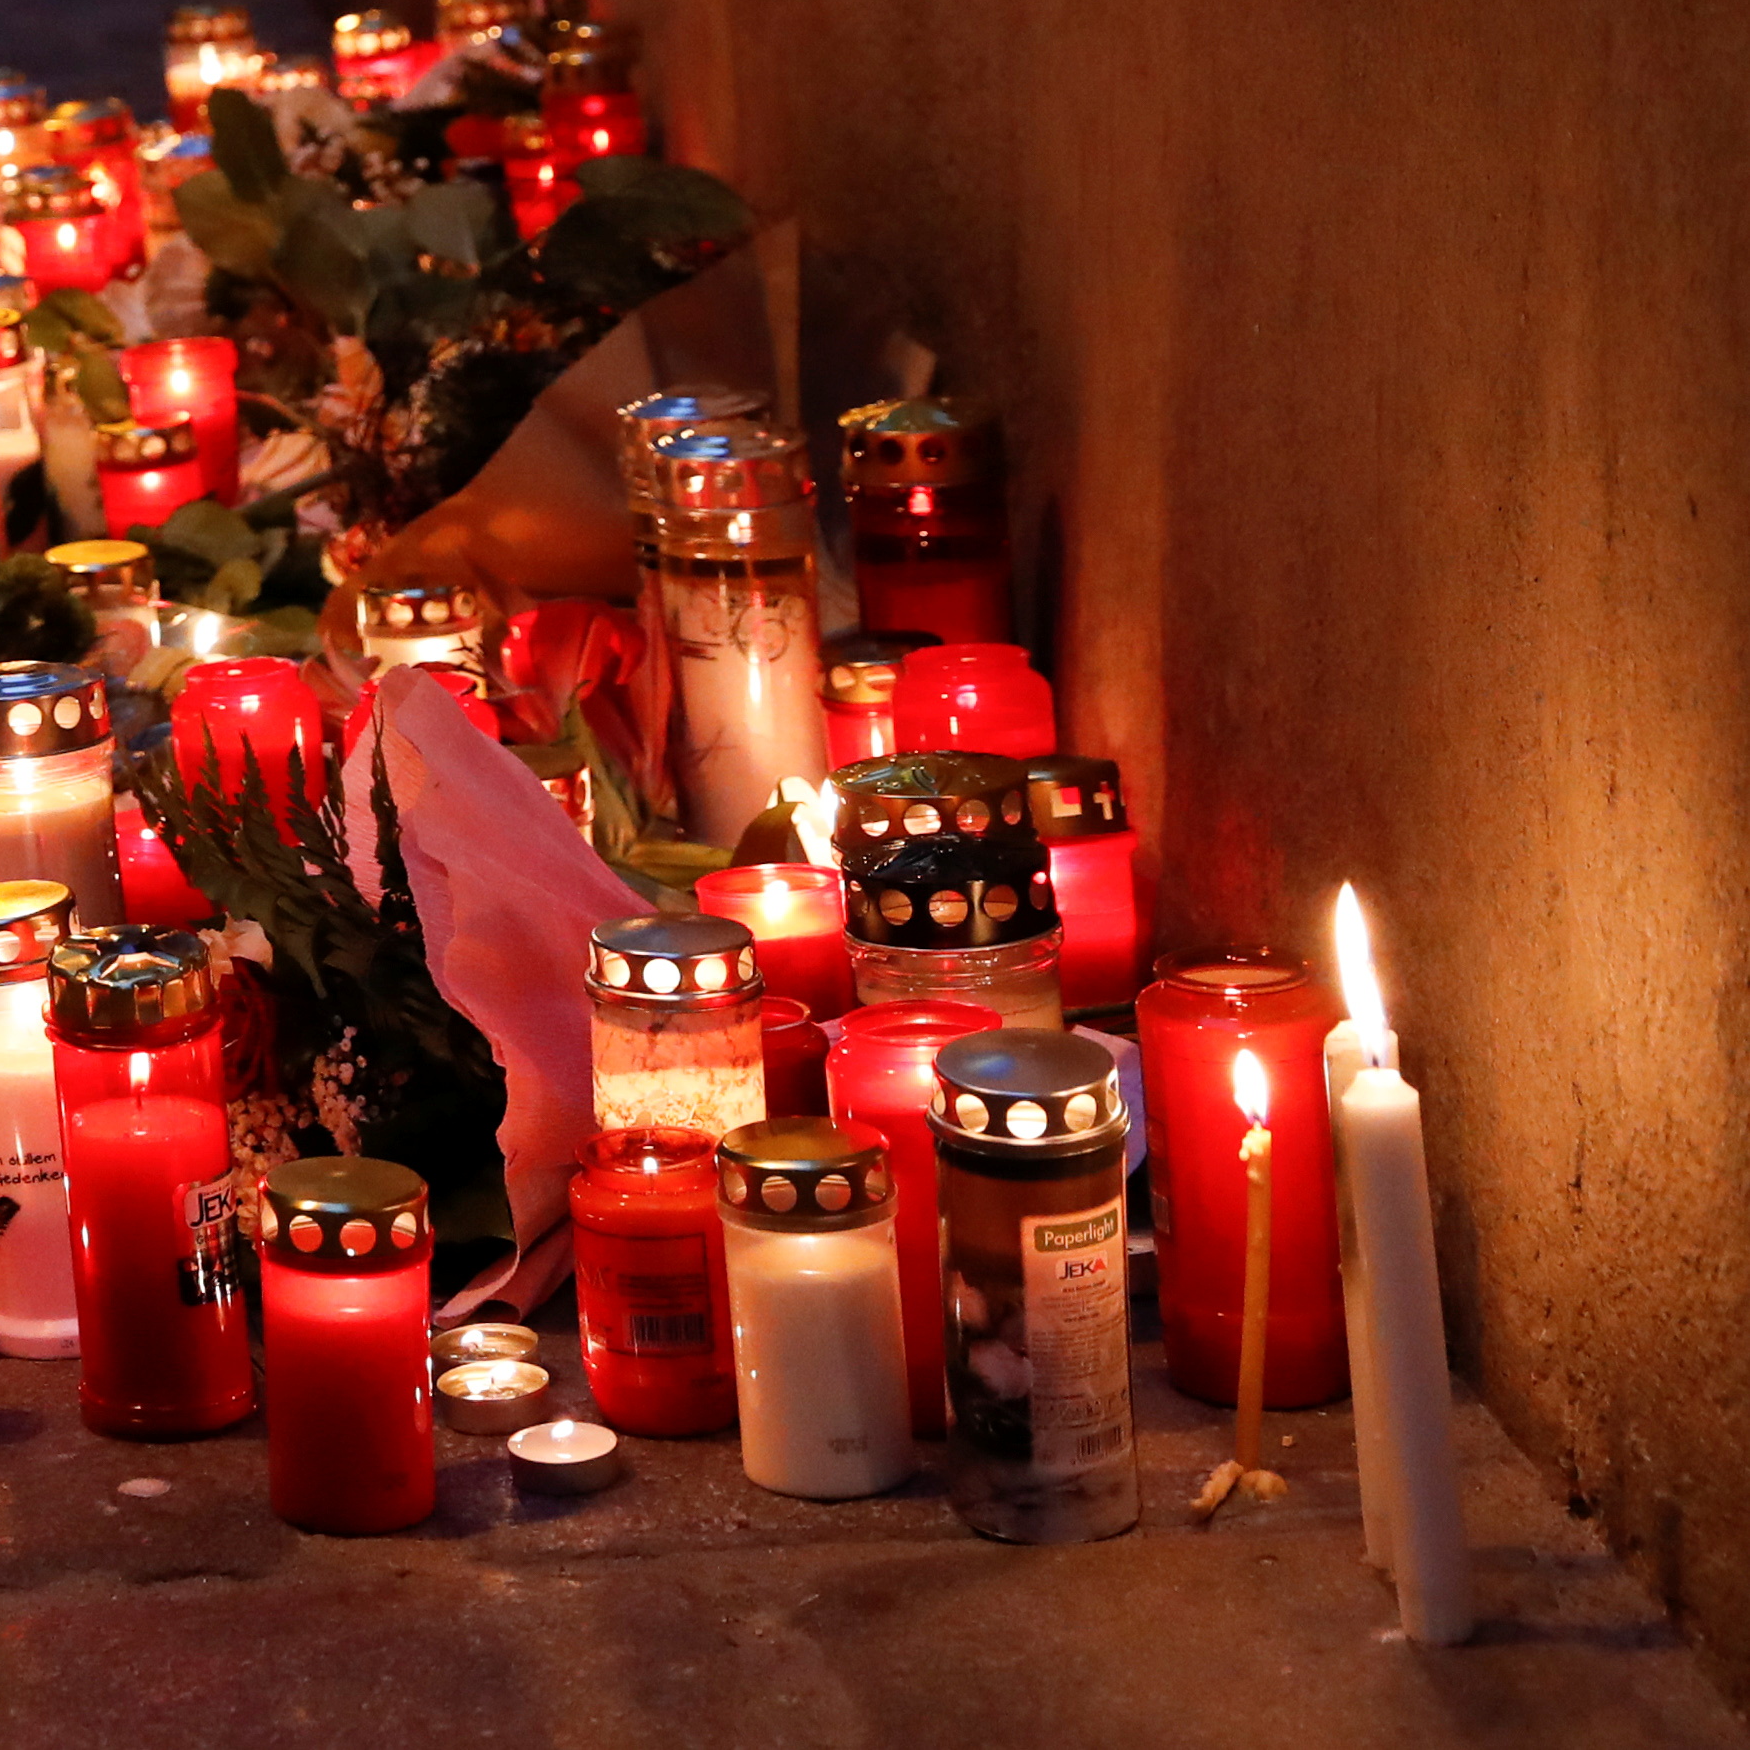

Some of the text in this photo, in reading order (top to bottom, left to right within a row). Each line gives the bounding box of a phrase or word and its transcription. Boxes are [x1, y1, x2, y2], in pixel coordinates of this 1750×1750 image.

[190, 1184, 235, 1227] JEK
[1044, 1218, 1114, 1249] Paperlight
[1059, 1258, 1106, 1280] JEKA
